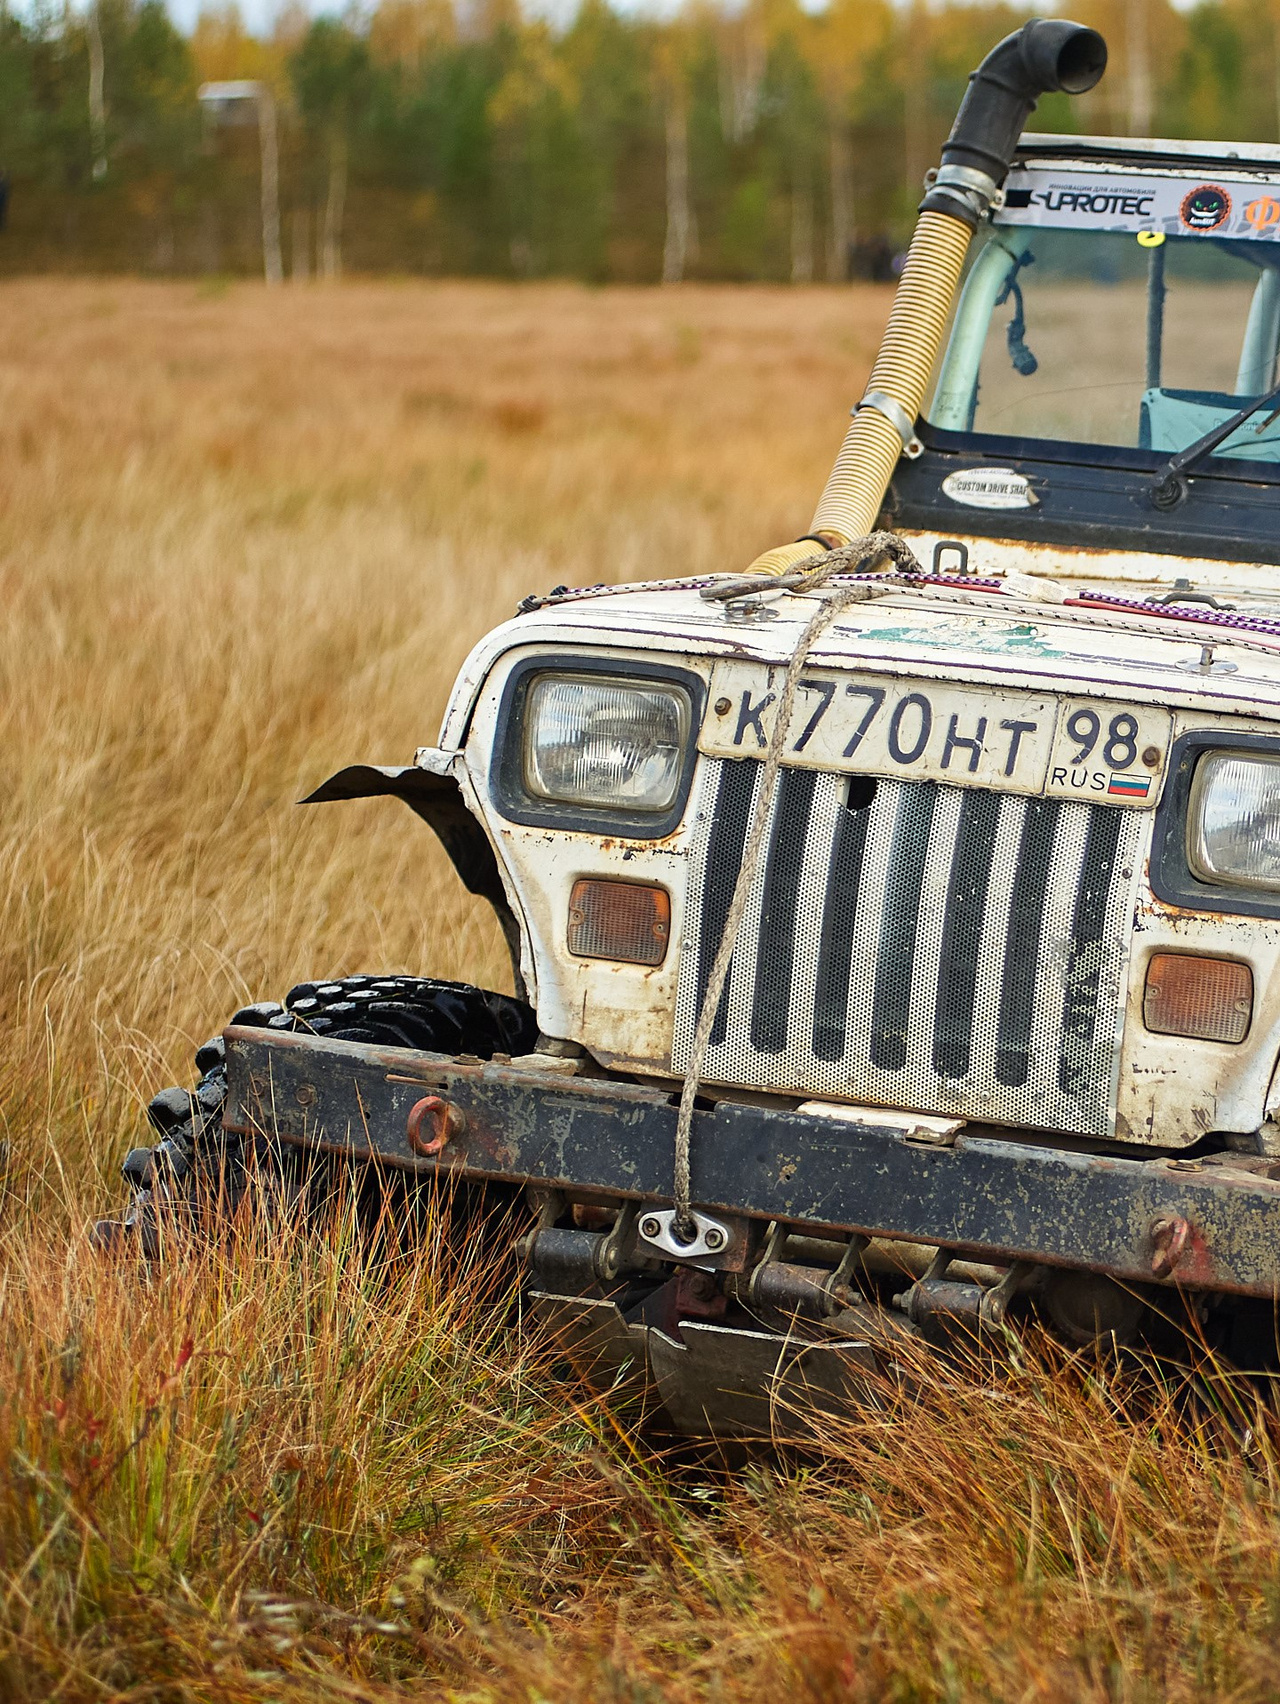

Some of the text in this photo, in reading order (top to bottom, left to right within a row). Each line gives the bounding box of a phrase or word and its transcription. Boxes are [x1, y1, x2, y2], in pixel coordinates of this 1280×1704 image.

[1093, 186, 1107, 194] ДЛЯ
[957, 481, 986, 492] CUSTOM
[987, 483, 1008, 494] DRIVE
[1065, 708, 1139, 770] 98
[1051, 768, 1106, 792] RUS
